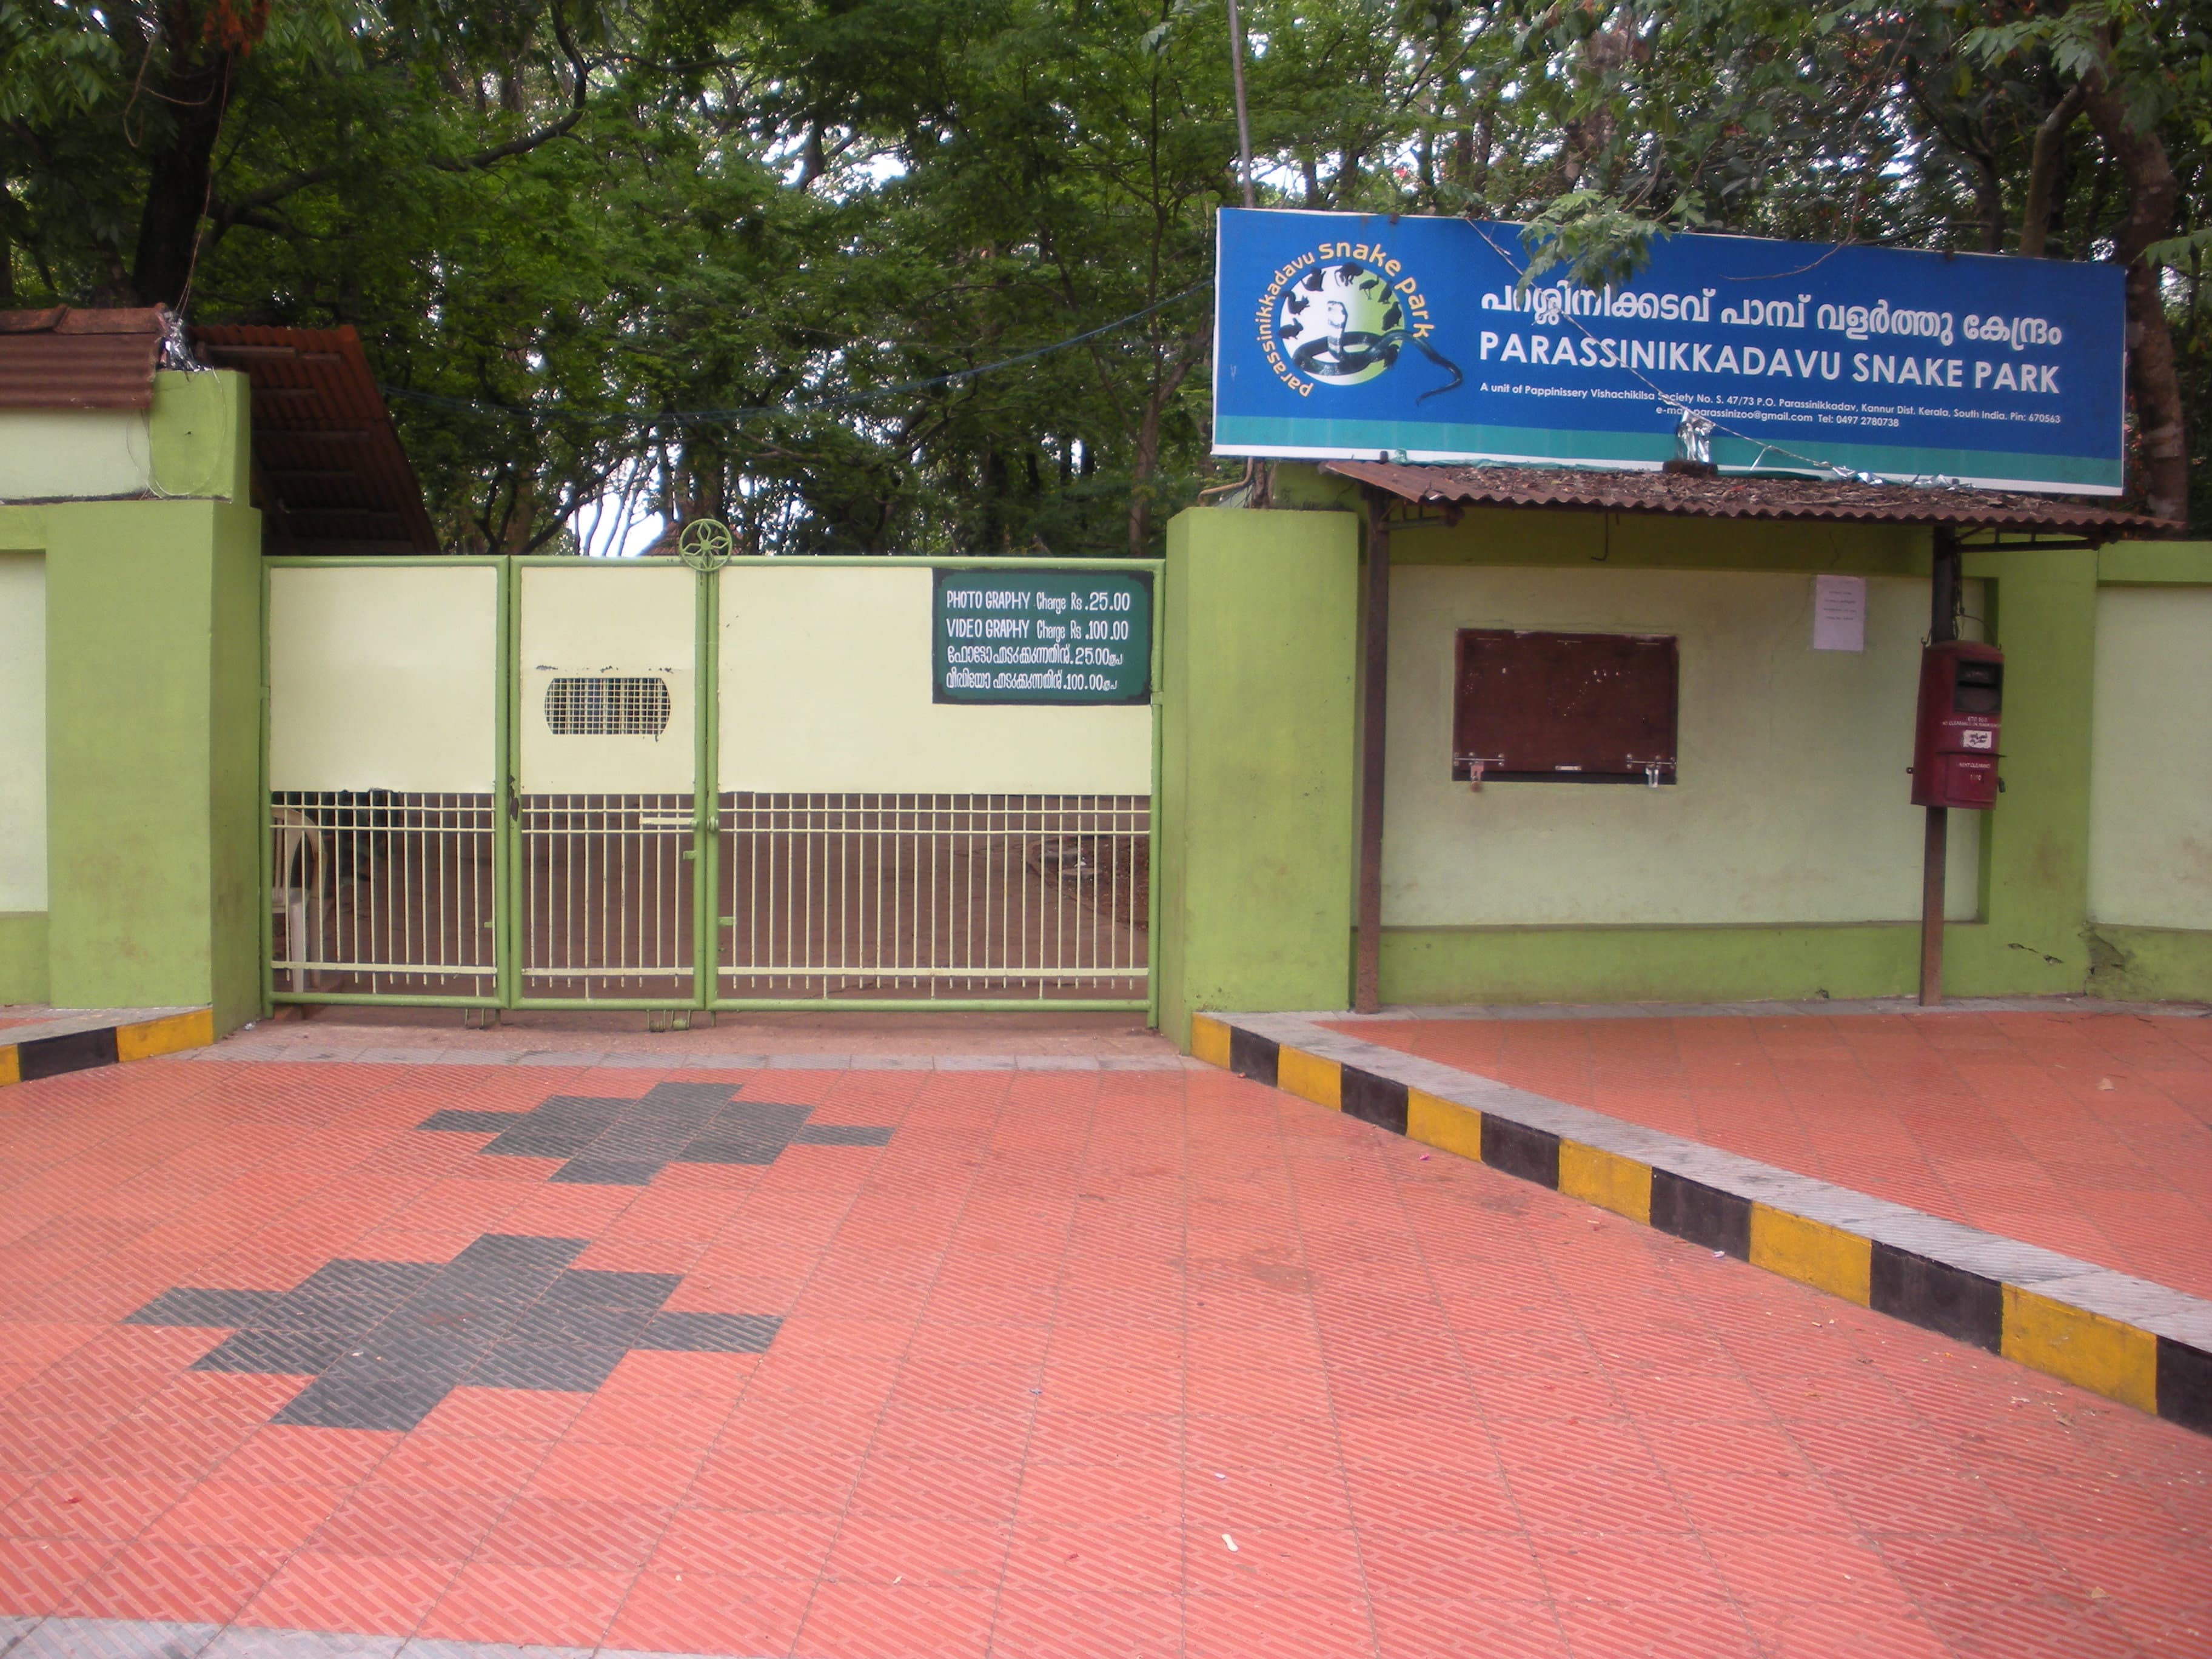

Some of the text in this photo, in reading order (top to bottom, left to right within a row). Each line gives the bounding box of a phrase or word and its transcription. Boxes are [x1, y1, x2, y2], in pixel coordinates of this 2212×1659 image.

[1255, 241, 1435, 397] parassinikkadavu snake park
[1720, 293, 1812, 328] പാമ്പ്
[1963, 314, 2062, 350] കേന്ദ്രം
[1480, 330, 2061, 394] PARASSINIKKADAVU SNAKE PARK
[1480, 383, 1488, 391] A
[1491, 384, 1510, 392] unit
[1512, 385, 1523, 394] of
[1525, 386, 1587, 399] Pappinissery
[1657, 392, 1694, 404] Sciety
[1697, 394, 1713, 404] No.
[1716, 395, 1724, 404] S.
[1727, 395, 1754, 406] 47/73
[1757, 397, 1776, 407] P.O.
[1862, 404, 1894, 414] Kannur
[1897, 406, 1915, 415] Dist.
[1954, 408, 1979, 419] South
[2010, 412, 2026, 421] Pin:
[2028, 414, 2061, 424] 670563
[1818, 414, 1834, 423] Tel:
[1836, 415, 1858, 424] 0497
[1861, 417, 1899, 427] 2780738
[947, 591, 982, 609] PHOTO
[985, 591, 1030, 609] GRAPHY
[1036, 591, 1066, 614] Charge
[946, 618, 982, 637] VIDEO
[985, 619, 1030, 638] GRAPHY
[1036, 620, 1065, 643] Charge
